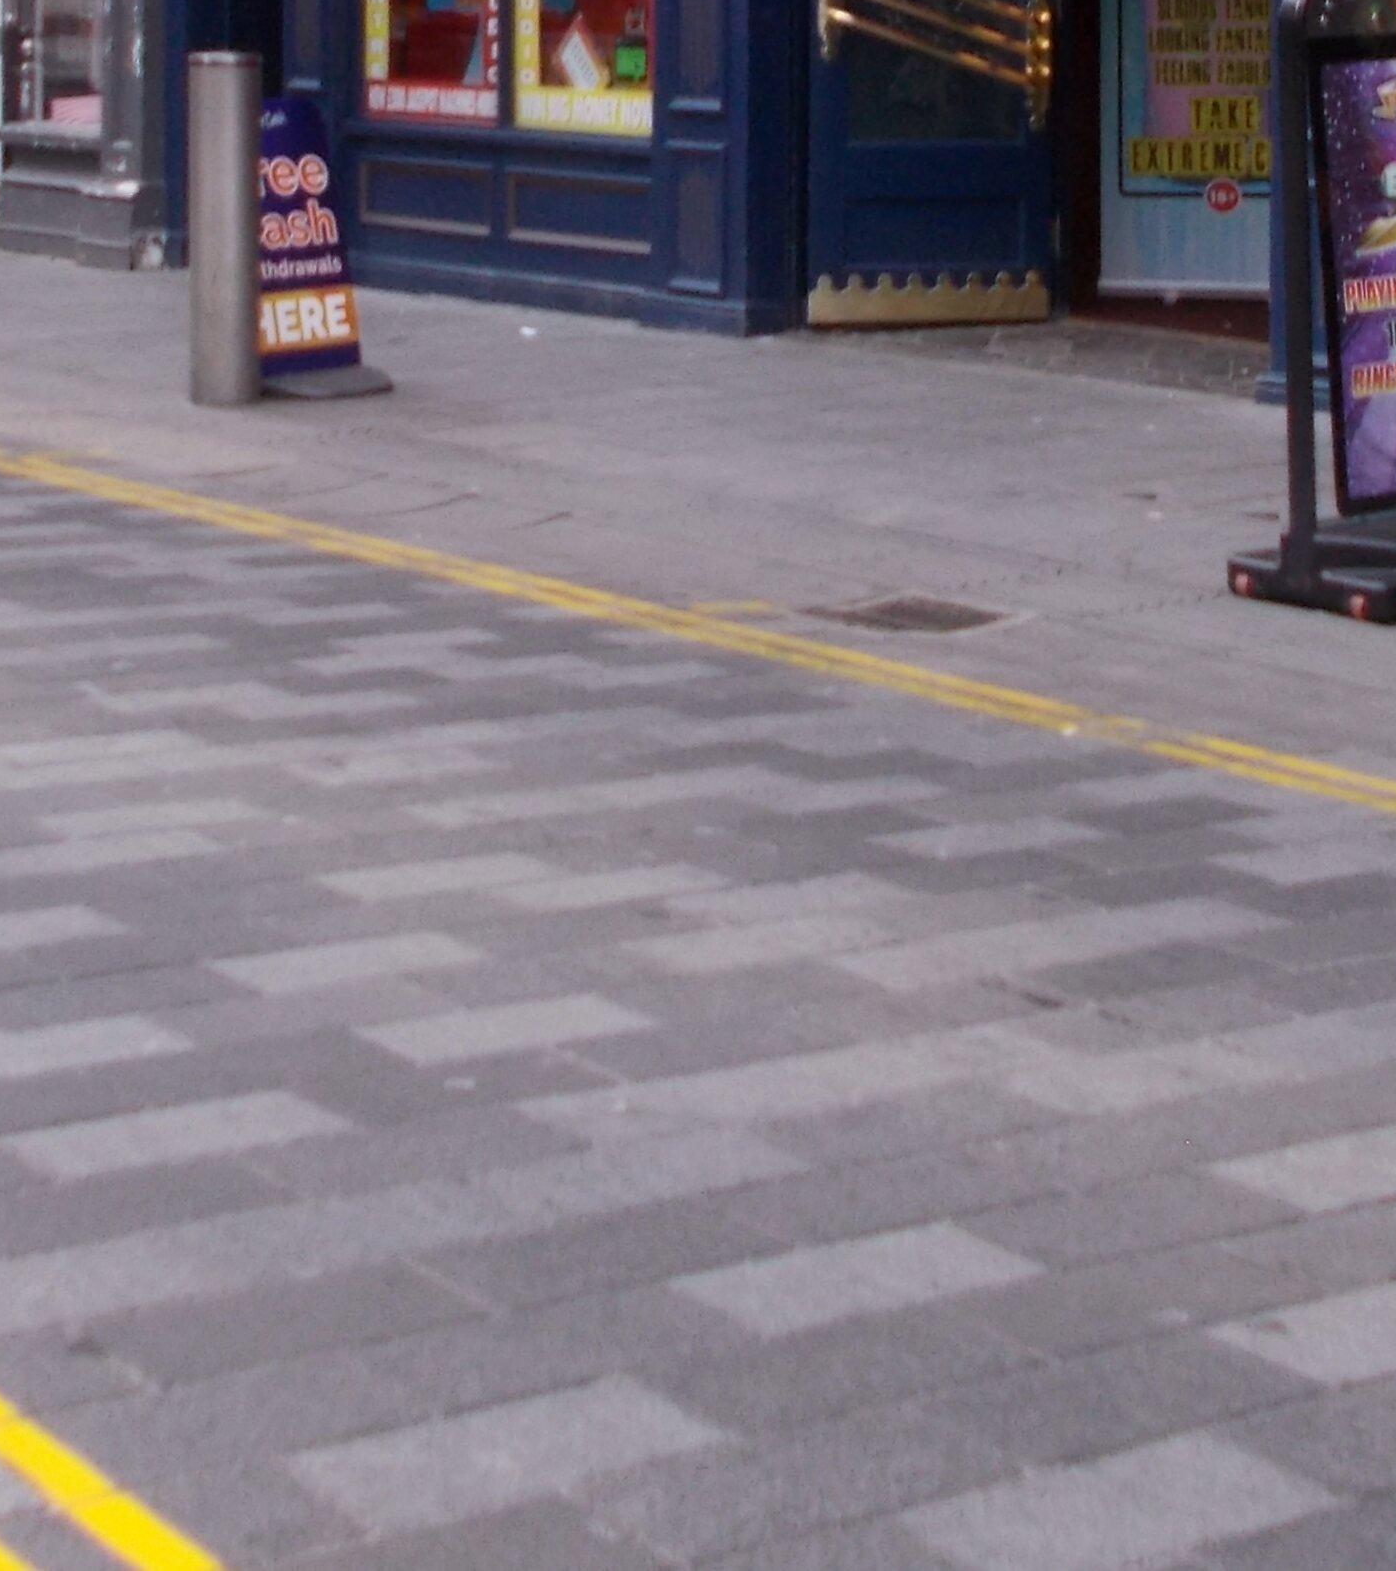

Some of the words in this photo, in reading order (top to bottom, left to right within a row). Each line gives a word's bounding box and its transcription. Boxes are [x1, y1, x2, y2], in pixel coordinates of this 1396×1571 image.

[259, 153, 330, 197] ree
[260, 198, 339, 250] ash
[260, 253, 343, 280] thdrawals
